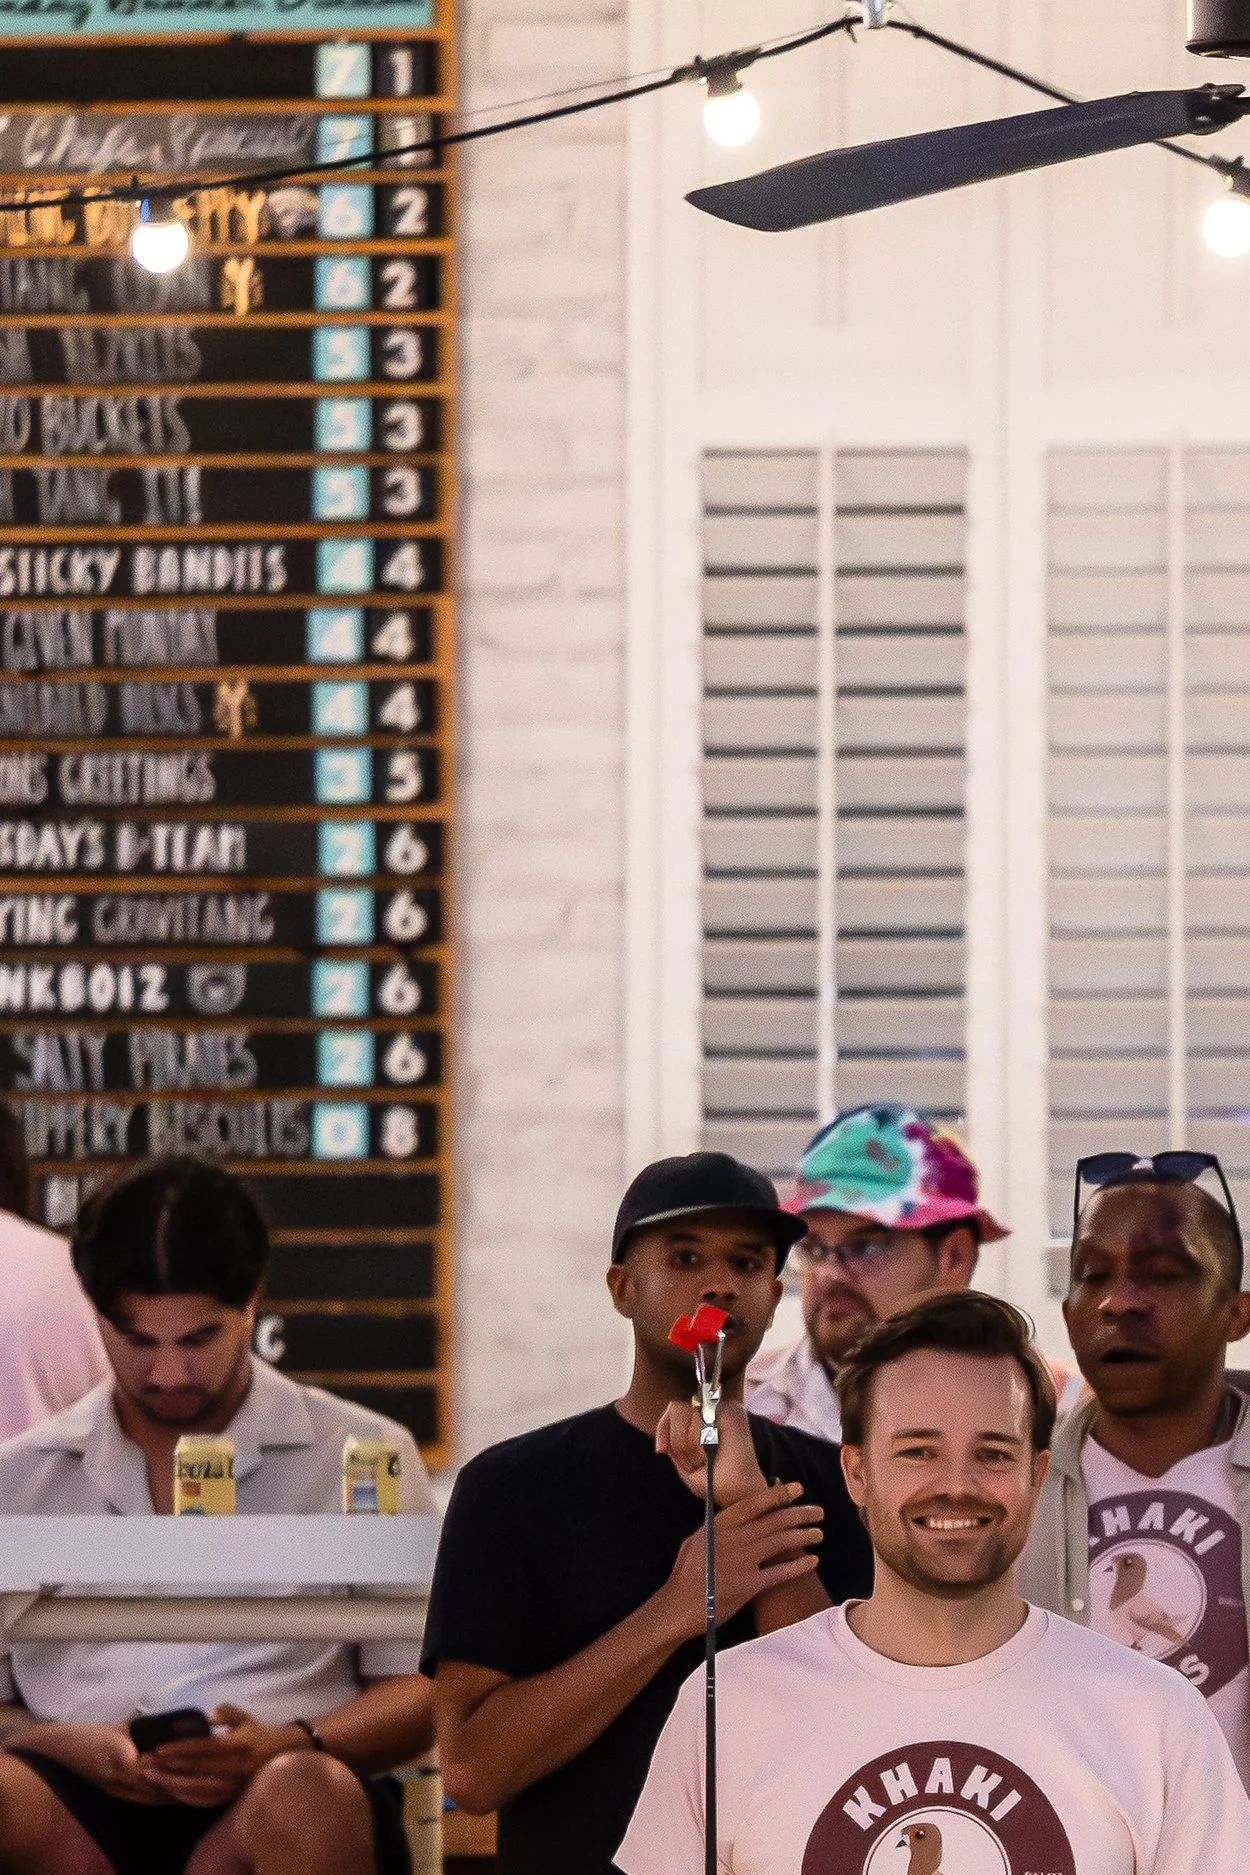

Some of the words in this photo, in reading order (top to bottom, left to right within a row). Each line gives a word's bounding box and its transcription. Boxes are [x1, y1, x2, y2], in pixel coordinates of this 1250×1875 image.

[388, 49, 414, 95] 1
[393, 188, 428, 235] 2
[380, 260, 417, 308] 2
[385, 330, 422, 378] 3
[384, 402, 423, 450] 3
[383, 466, 422, 515] 3
[330, 544, 371, 592] 4
[381, 545, 424, 590] 4
[320, 614, 362, 662] 4
[371, 612, 415, 662] 4
[328, 688, 366, 732] 4
[379, 684, 422, 732] 4
[386, 752, 423, 801] 5
[328, 826, 364, 873] 2
[384, 824, 429, 874] 6
[328, 896, 364, 942] 2
[384, 890, 428, 943] 6
[326, 966, 359, 1013] 2
[379, 963, 423, 1015] 6
[328, 1036, 364, 1084] 2
[382, 1032, 428, 1084] 6
[380, 1105, 420, 1158] 8
[1088, 1502, 1226, 1556] HAKI
[842, 1757, 1022, 1831] KHAKI
